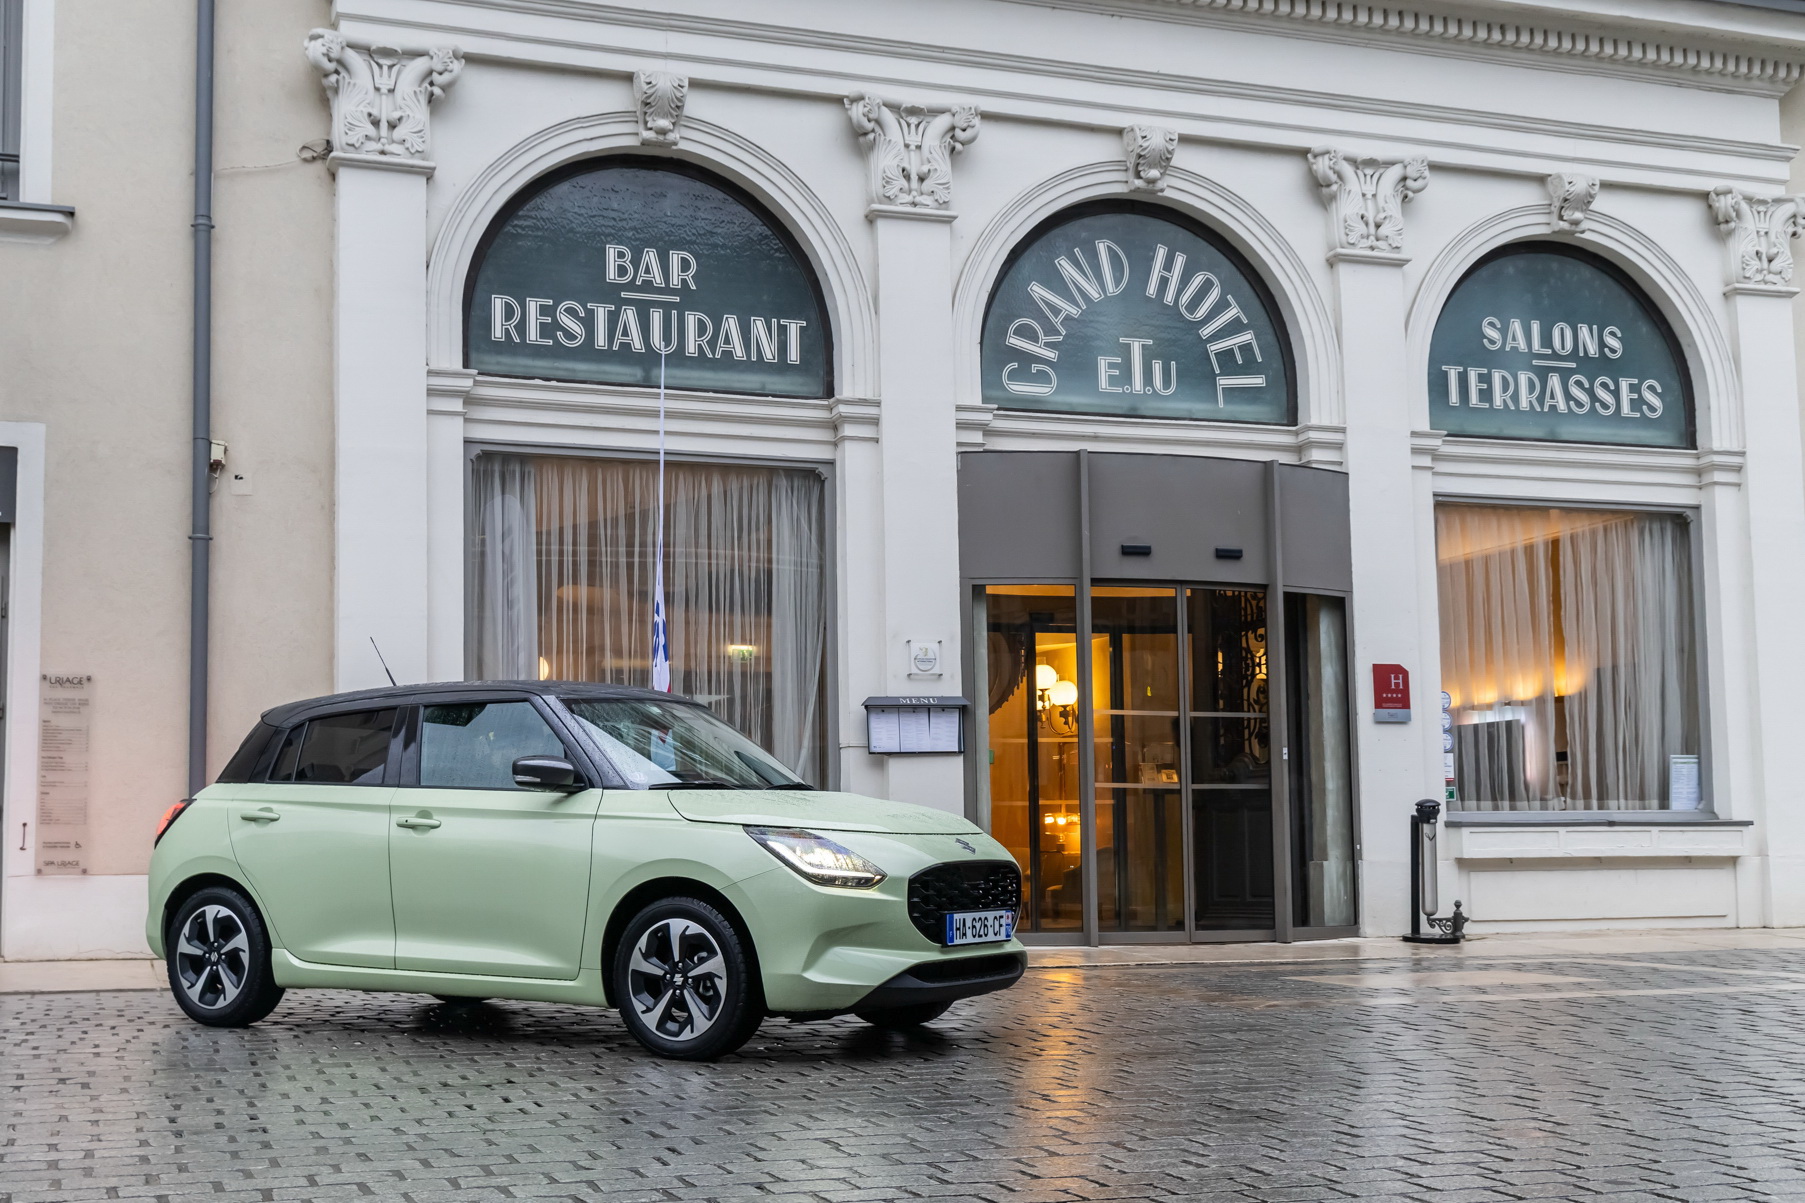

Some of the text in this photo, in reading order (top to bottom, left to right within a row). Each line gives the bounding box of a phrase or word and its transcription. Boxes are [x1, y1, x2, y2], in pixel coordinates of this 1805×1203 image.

[605, 244, 698, 290] BAR
[491, 294, 807, 364] RESTAURANT
[1002, 239, 1266, 408] GRAND HOTEL
[1481, 316, 1623, 359] SALONS
[1442, 365, 1664, 419] TERRASSES
[49, 676, 84, 686] URIAGE
[1390, 673, 1404, 689] H
